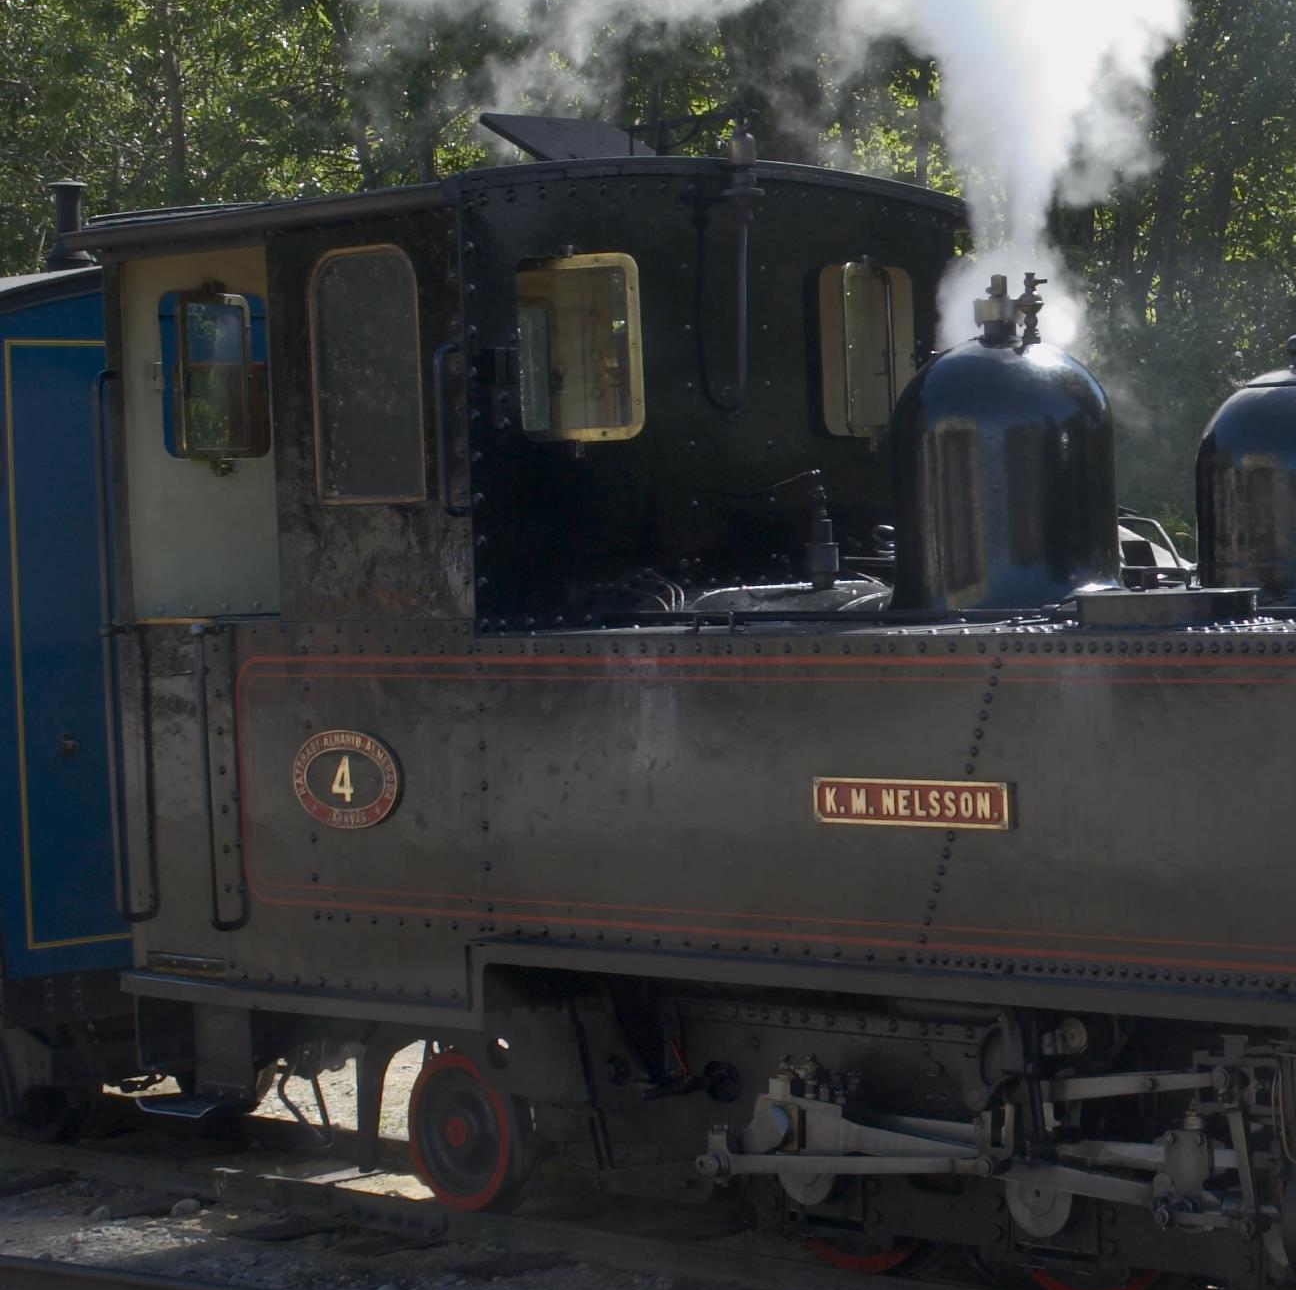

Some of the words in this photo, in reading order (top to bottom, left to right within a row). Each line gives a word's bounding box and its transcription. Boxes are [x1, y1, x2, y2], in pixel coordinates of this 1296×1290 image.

[331, 755, 354, 803] 4
[825, 787, 845, 814] K.
[851, 788, 874, 815] M.
[882, 788, 1000, 820] NELSSON.
